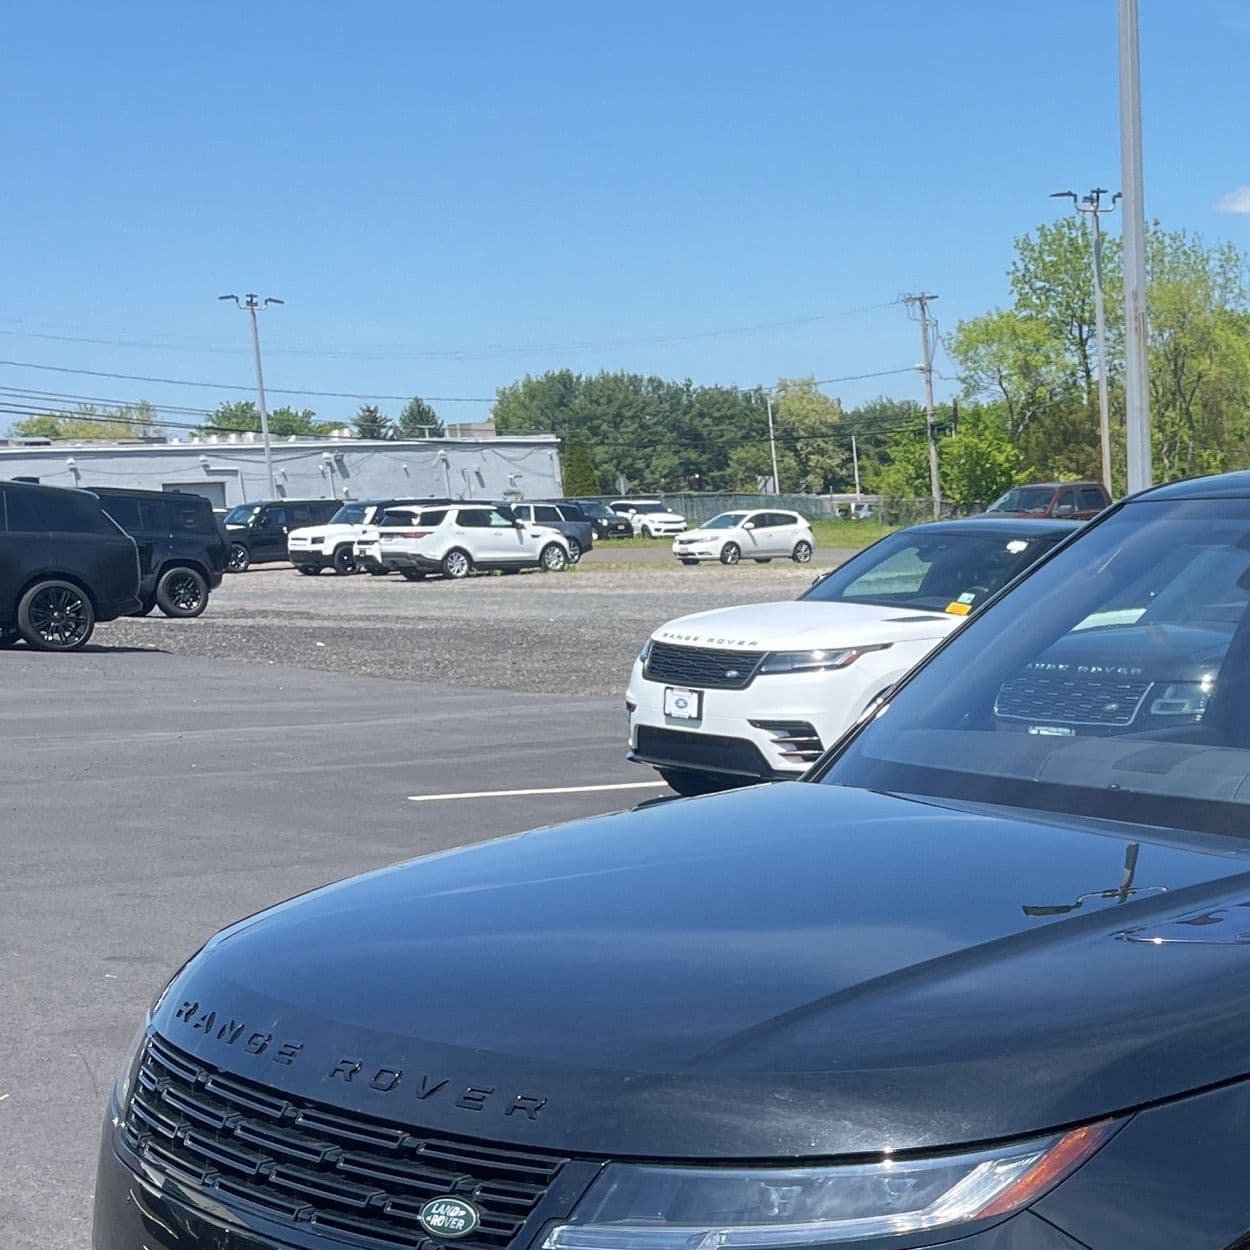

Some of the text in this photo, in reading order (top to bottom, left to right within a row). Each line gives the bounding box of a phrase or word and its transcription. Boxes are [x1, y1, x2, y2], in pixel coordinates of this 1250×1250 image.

[662, 632, 758, 646] RANGE ROVER
[176, 1000, 548, 1121] RANGE ROVER
[431, 1203, 461, 1217] LAND
[430, 1214, 466, 1230] ROVER
